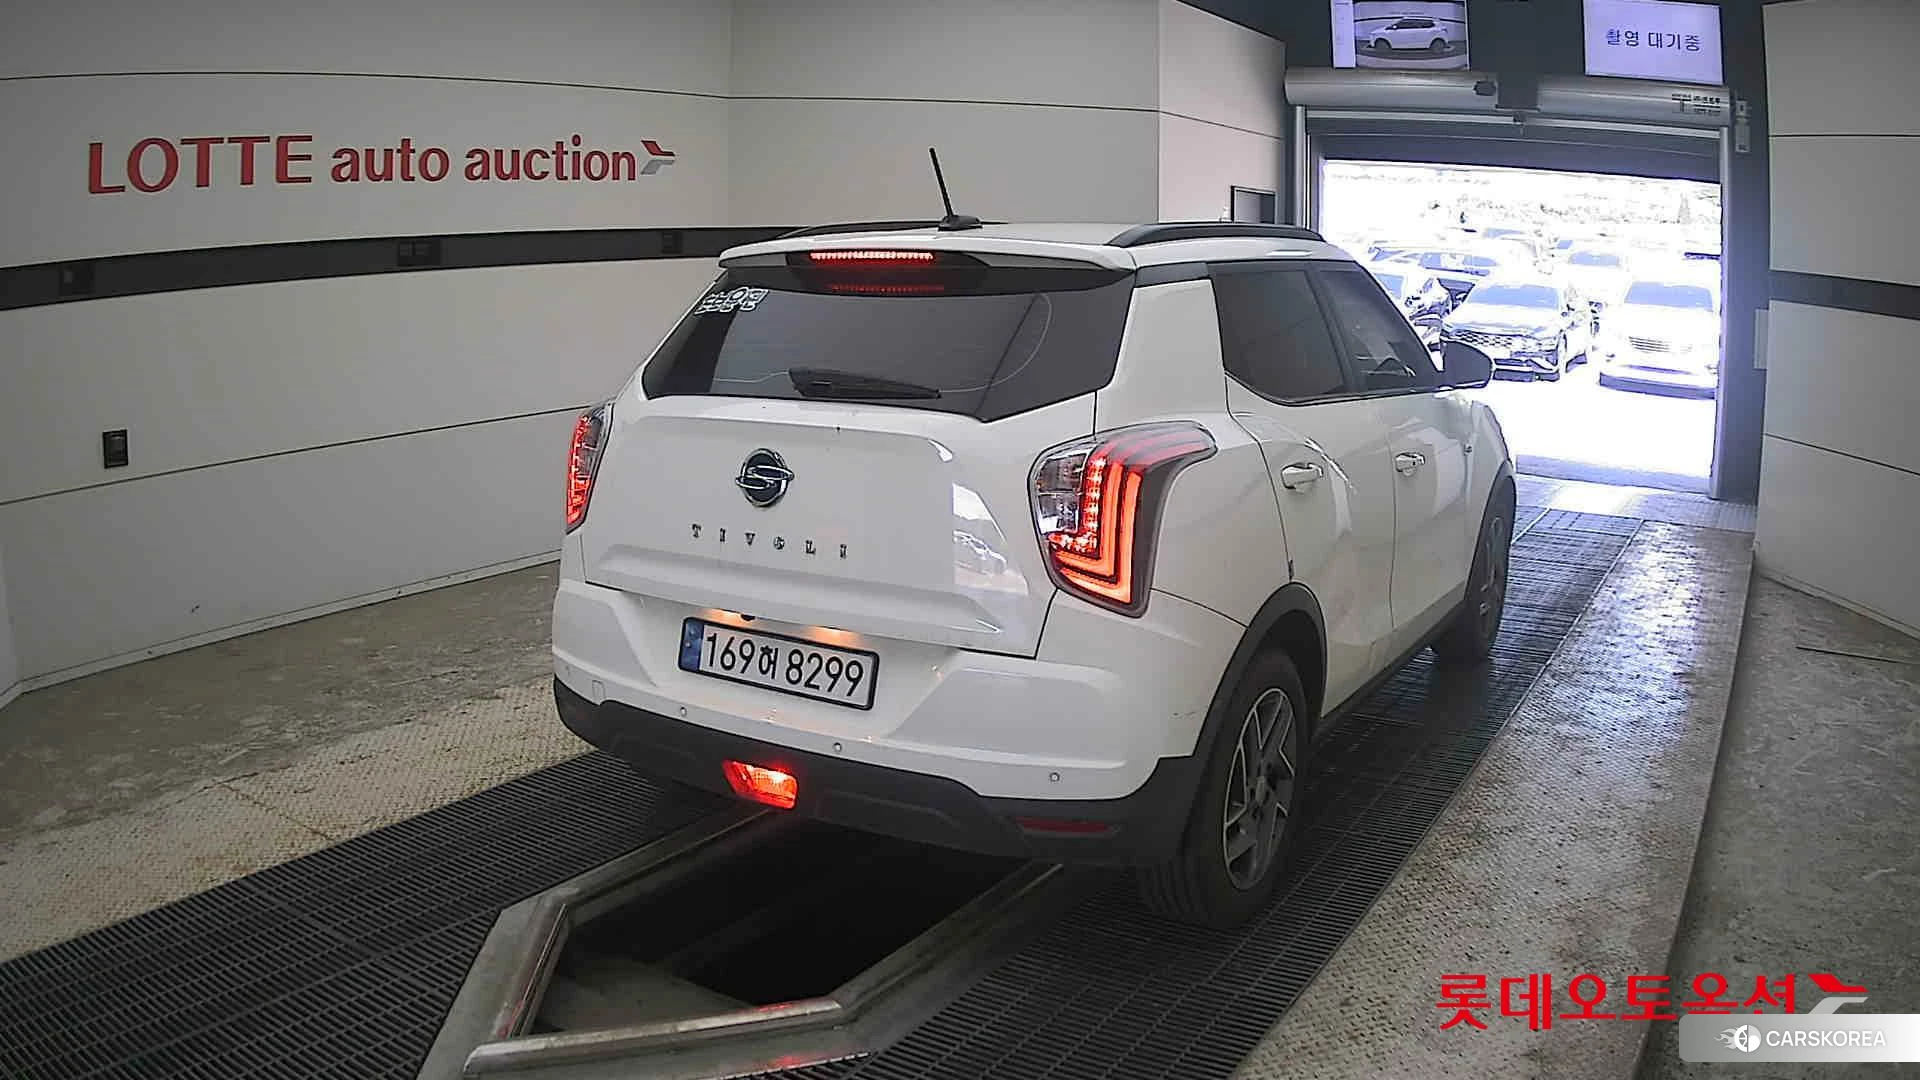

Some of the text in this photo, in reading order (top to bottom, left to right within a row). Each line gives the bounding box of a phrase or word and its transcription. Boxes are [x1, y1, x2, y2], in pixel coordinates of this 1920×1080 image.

[1606, 29, 1702, 52] 촬영 대기중
[88, 134, 638, 194] LOTTE auto auction
[691, 523, 848, 559] TIVOLI
[706, 632, 864, 697] 169허 8299
